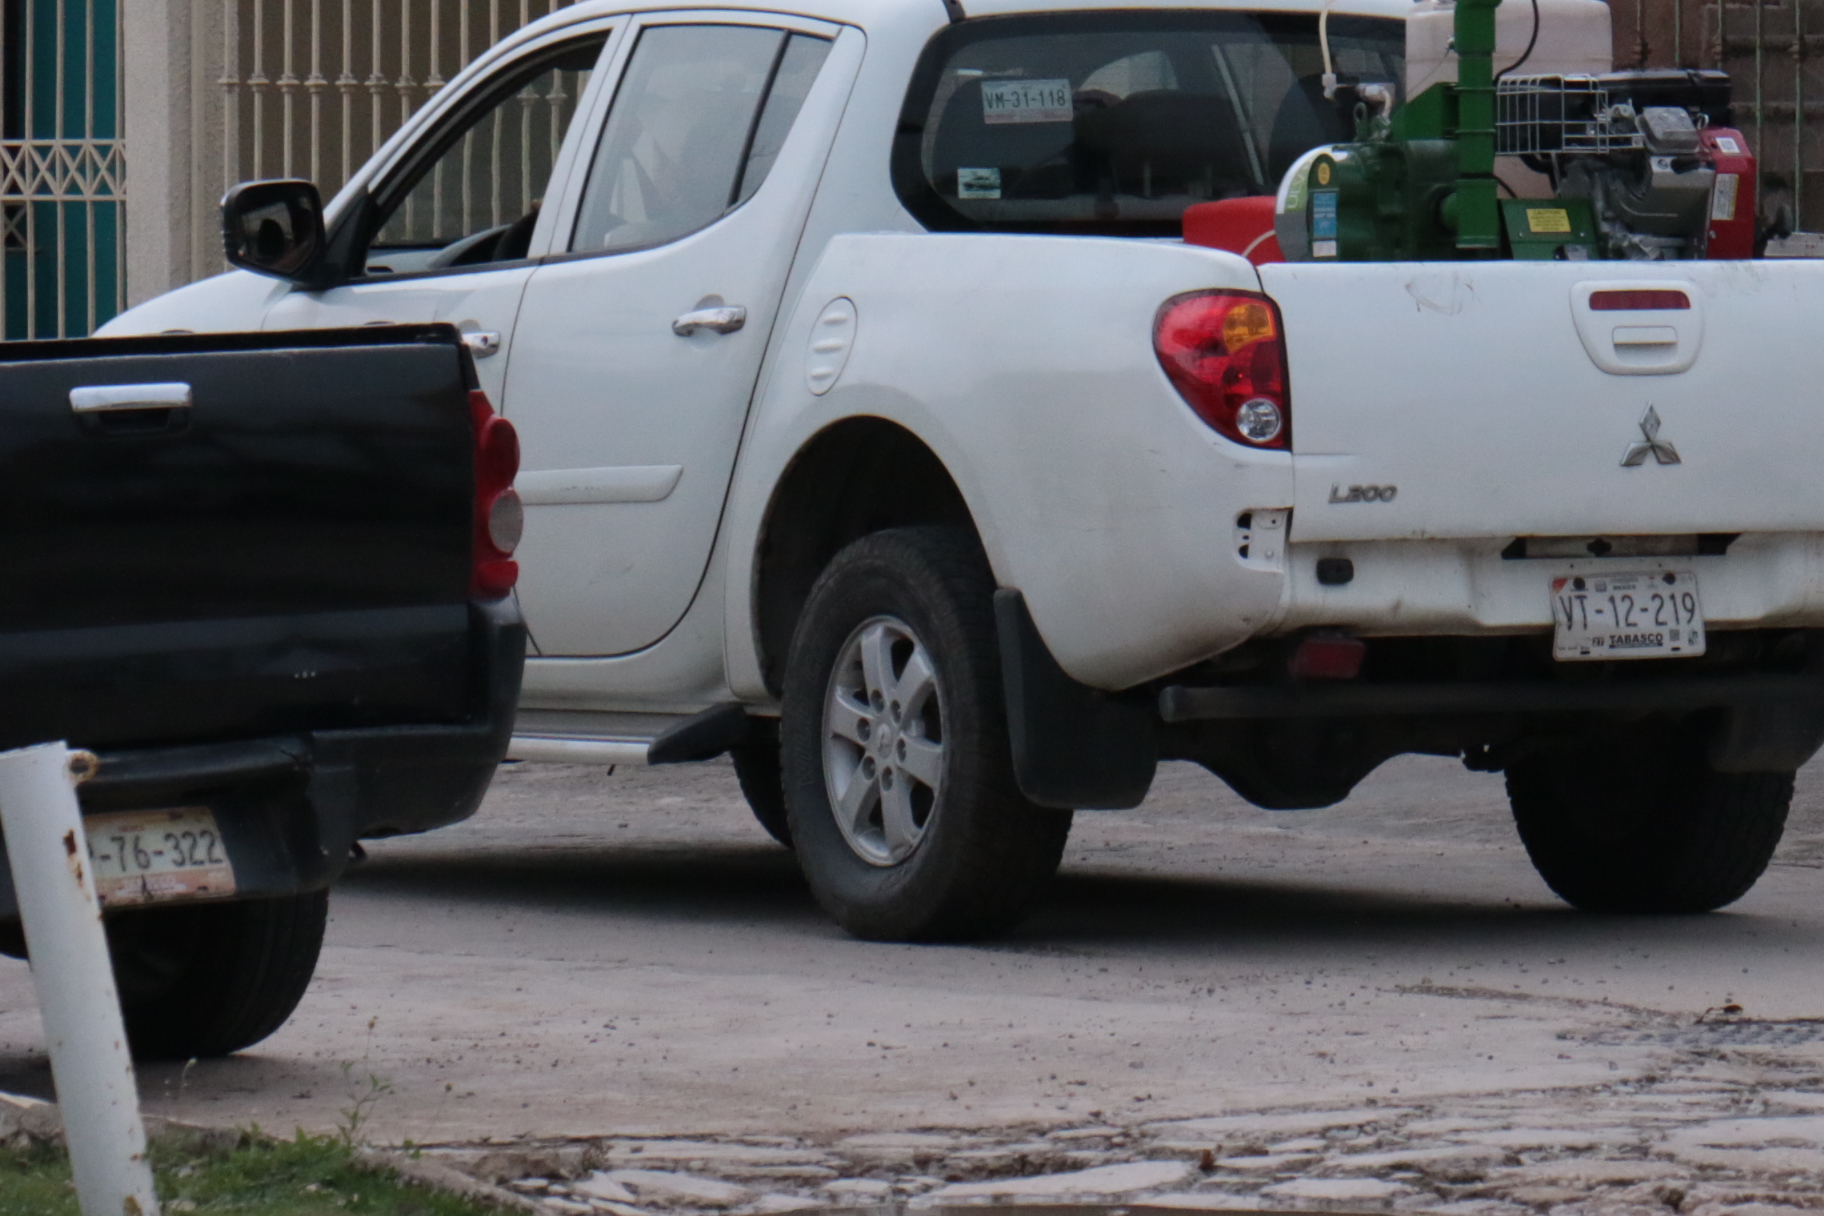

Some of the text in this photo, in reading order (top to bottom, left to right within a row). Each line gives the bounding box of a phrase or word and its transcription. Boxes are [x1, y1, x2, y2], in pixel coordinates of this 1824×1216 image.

[985, 89, 1066, 110] VM-31-118
[1558, 592, 1696, 631] VT-12-219
[1608, 633, 1663, 646] TABASCO
